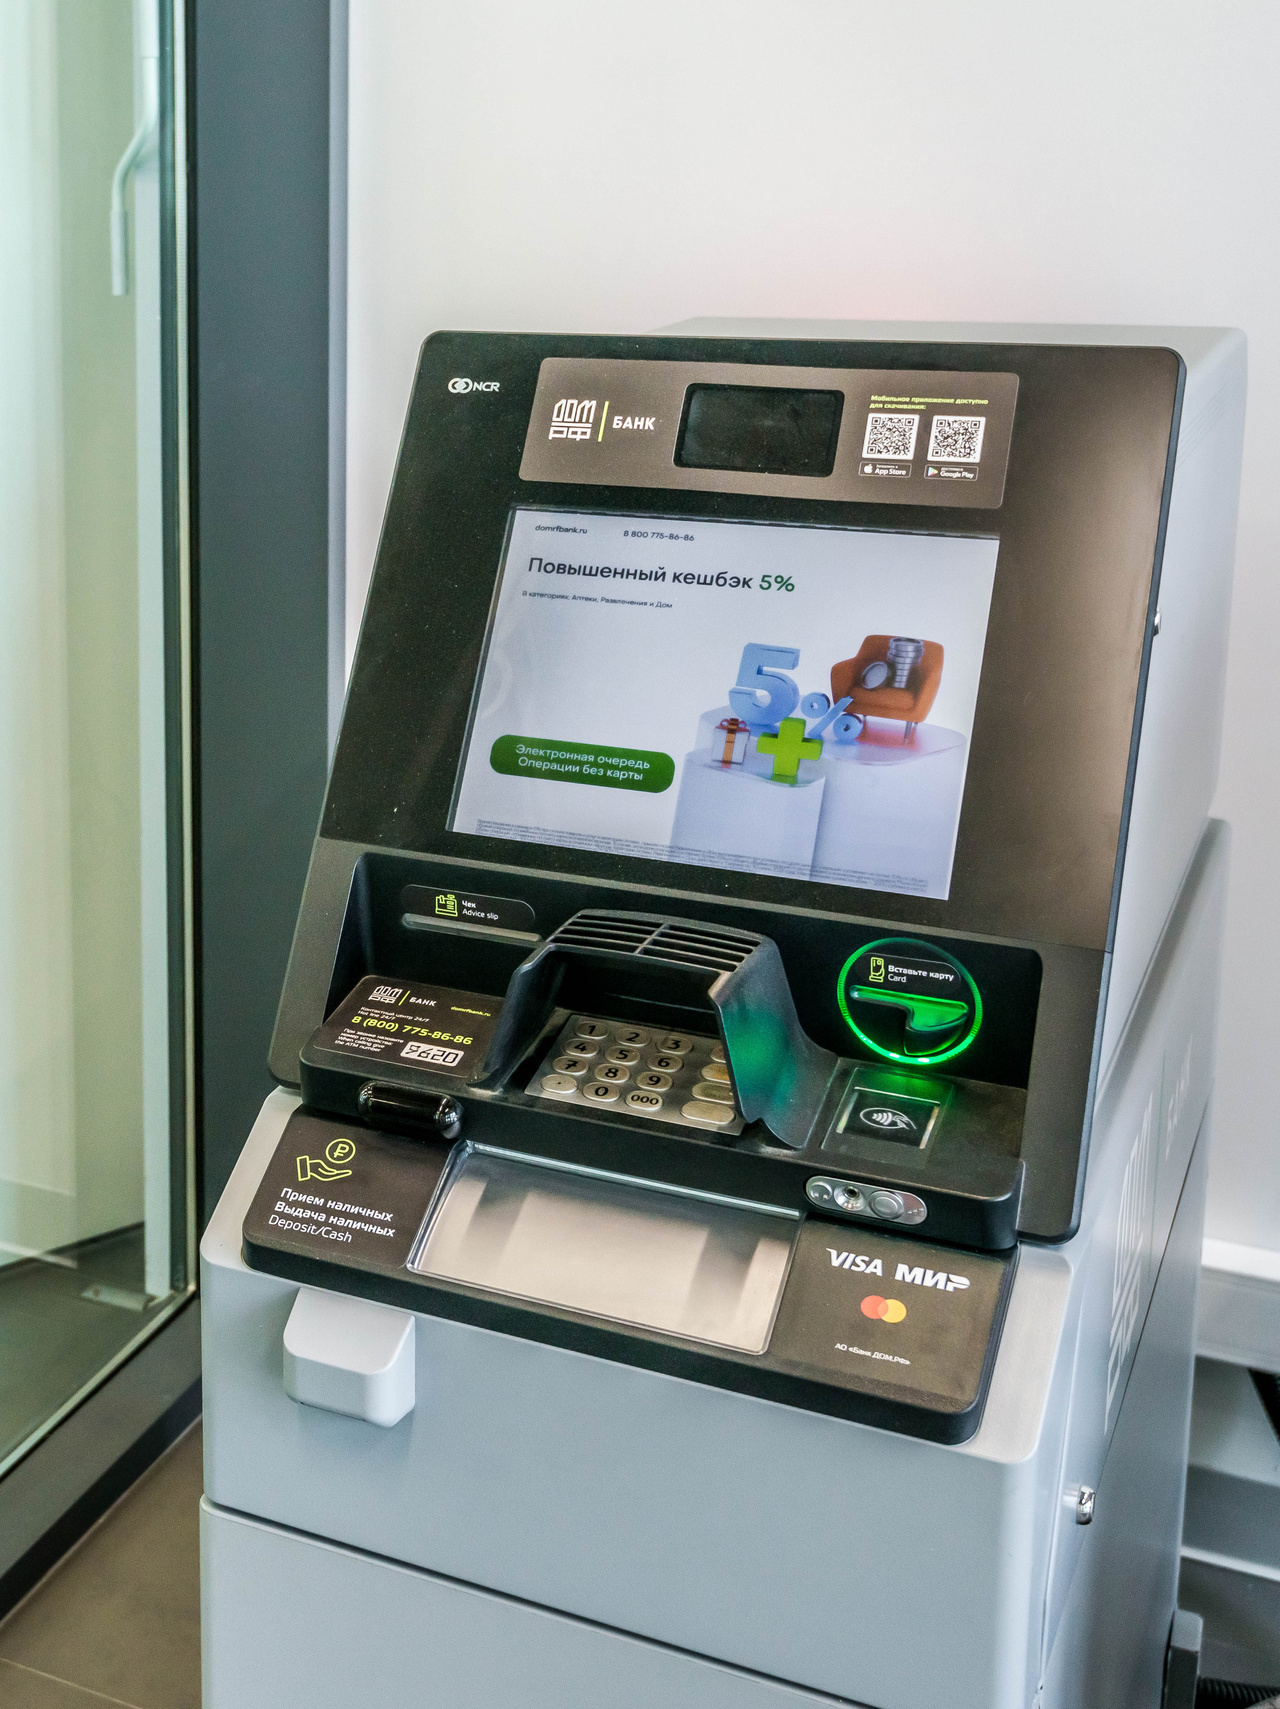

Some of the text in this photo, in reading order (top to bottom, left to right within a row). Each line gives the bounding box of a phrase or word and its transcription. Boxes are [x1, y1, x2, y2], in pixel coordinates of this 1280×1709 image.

[472, 381, 501, 393] NCR
[870, 395, 989, 406] Мобильное приложение доступно
[552, 399, 597, 423] ДОМ
[612, 415, 656, 430] БАНК
[939, 470, 974, 479] Google Play
[534, 524, 588, 535] domrfbank.ru
[623, 530, 695, 542] 8 800 775-86-86
[528, 557, 796, 593] Повышенный кешбэк 5%
[655, 601, 673, 609] Дом
[516, 744, 651, 770] Электронная очередь
[518, 757, 644, 781] Операции без карты
[462, 900, 476, 909] Чек
[462, 908, 499, 921] Advice slip
[887, 973, 907, 983] Card
[888, 965, 955, 982] Вставьте карту
[409, 997, 437, 1007] БАНК
[351, 1016, 474, 1045] 8 (800) 775-86-86
[588, 1025, 682, 1050] 1 2 3
[574, 1042, 670, 1068] 4 5 6
[564, 1060, 661, 1086] 7 8 9
[594, 1086, 659, 1106] 0 000
[280, 1187, 394, 1222] Прием наличных
[268, 1214, 353, 1243] Deposit/Cash
[274, 1201, 396, 1238] Выдача наличных
[826, 1247, 884, 1277] VISA
[894, 1263, 971, 1292] МИР
[834, 1342, 848, 1351] АО
